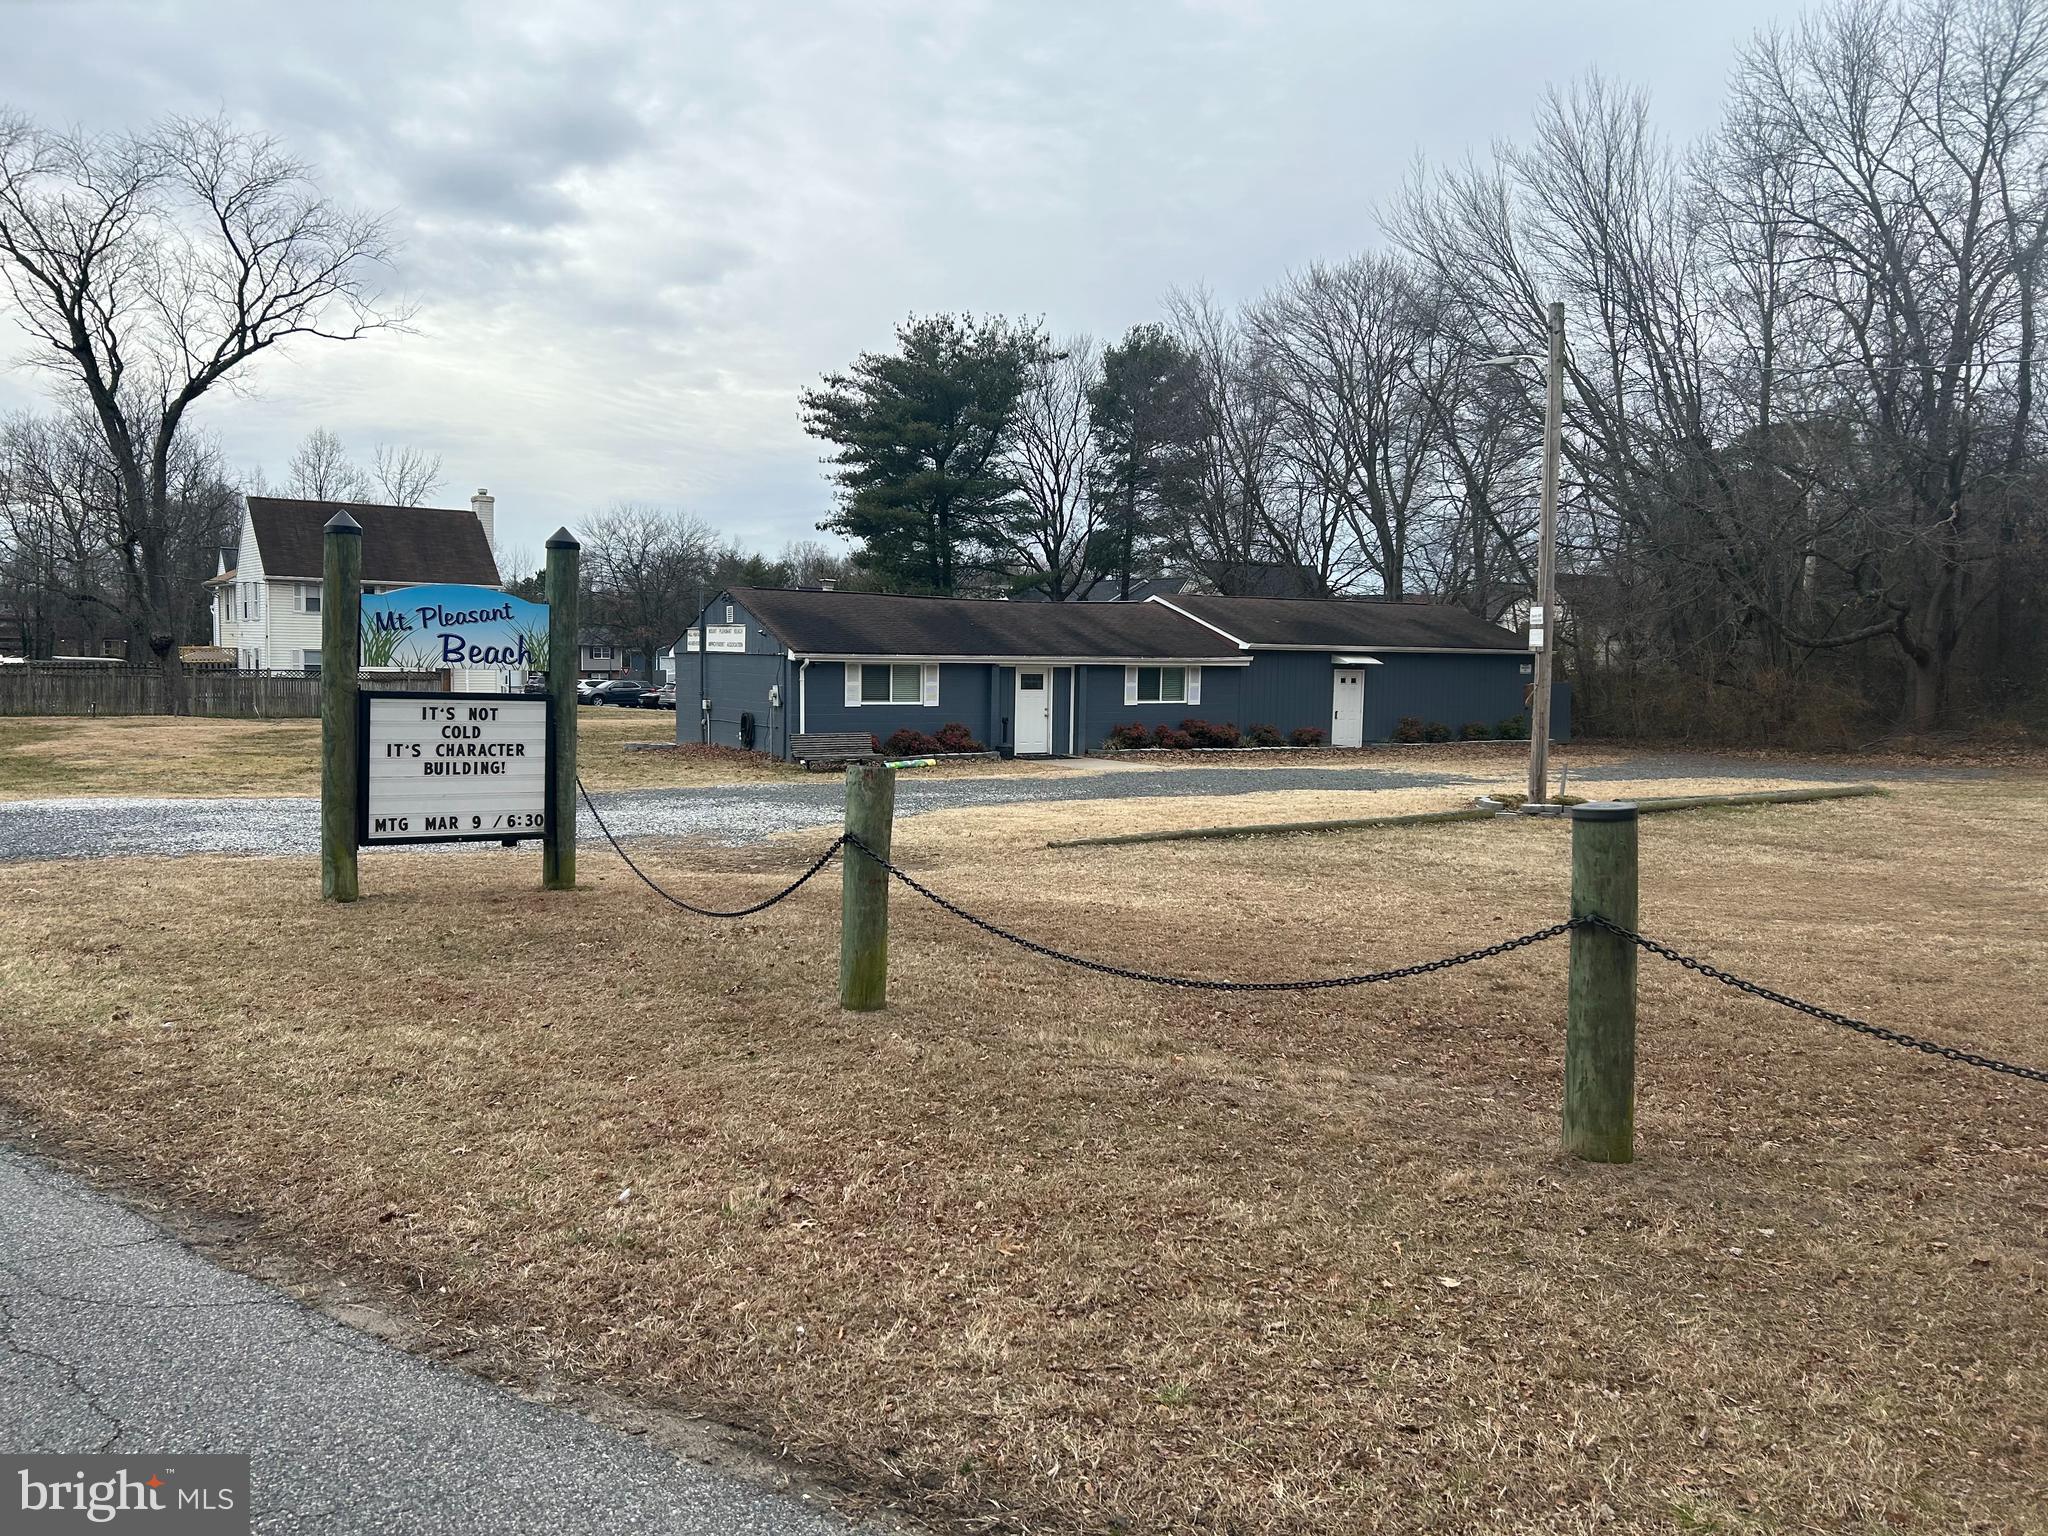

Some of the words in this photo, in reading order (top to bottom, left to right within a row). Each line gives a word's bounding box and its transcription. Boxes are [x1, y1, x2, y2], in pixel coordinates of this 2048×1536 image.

[375, 611, 413, 633] Mt.
[416, 602, 515, 629] Pleasant
[437, 633, 537, 665] Beach
[422, 707, 455, 720] IT'S
[469, 708, 498, 721] NOT
[442, 726, 480, 739] COLD
[387, 744, 421, 757] IT'S
[436, 744, 524, 757] CHARACTER
[424, 761, 505, 775] BUILDING!
[375, 818, 408, 832] MTG
[426, 816, 458, 830] MAR
[472, 816, 481, 829] 9
